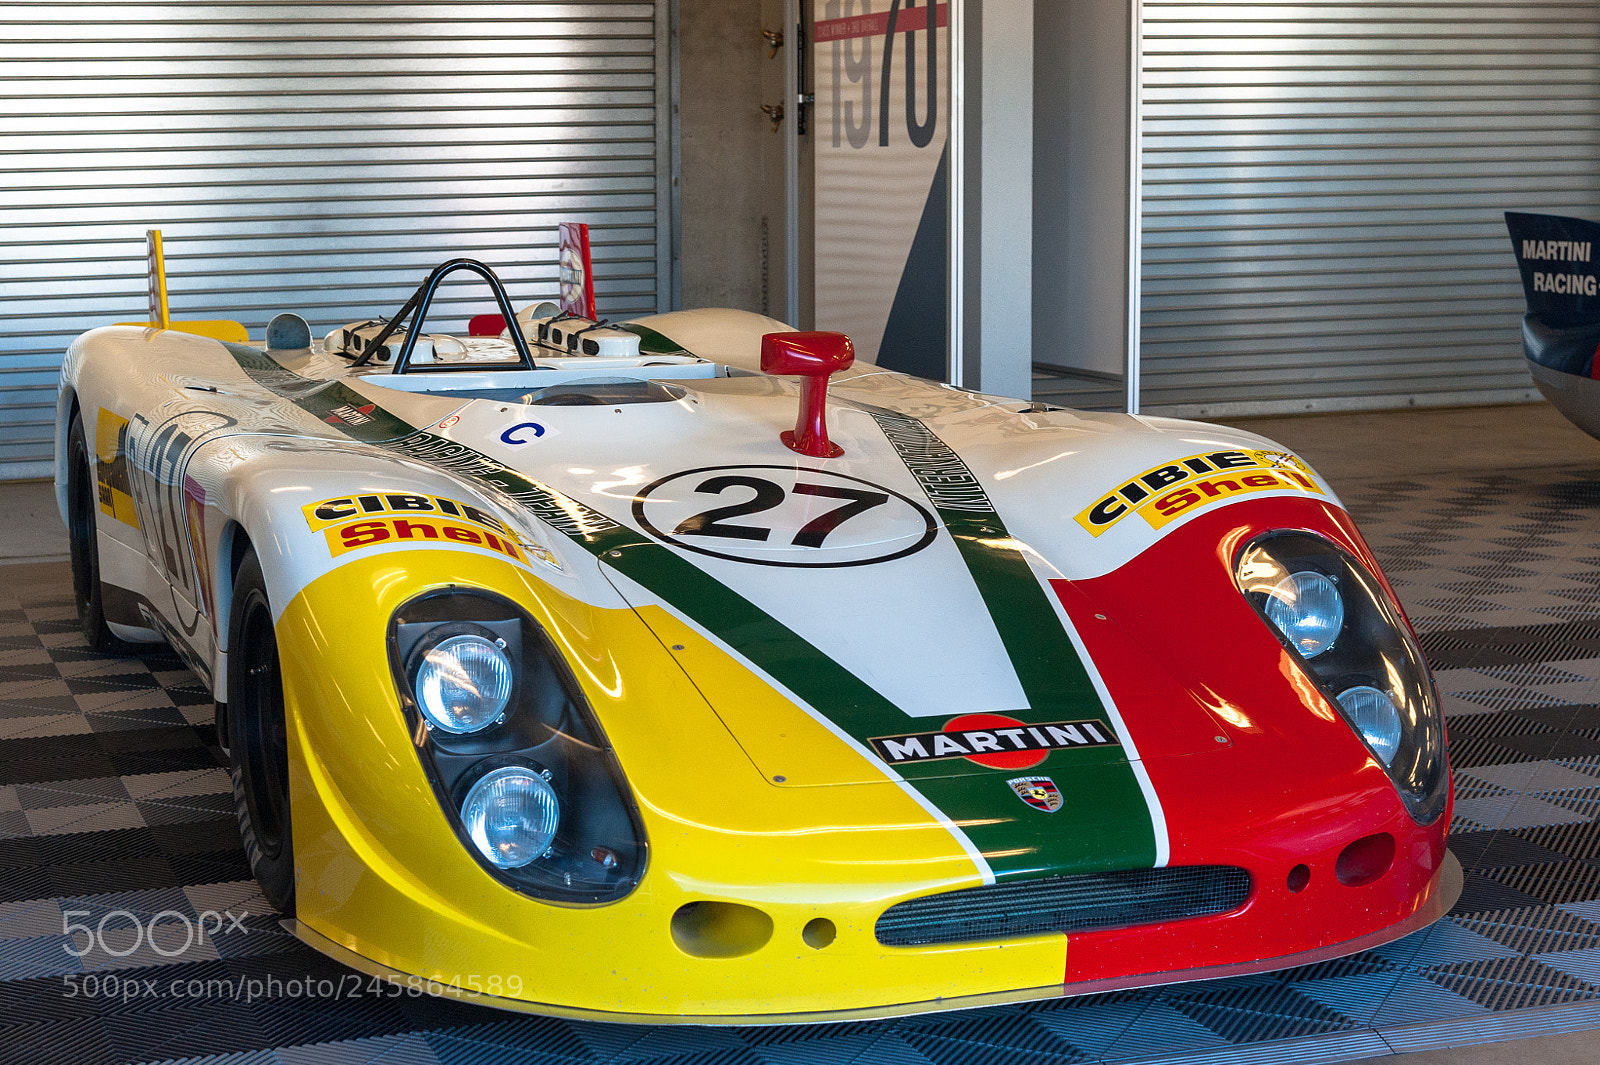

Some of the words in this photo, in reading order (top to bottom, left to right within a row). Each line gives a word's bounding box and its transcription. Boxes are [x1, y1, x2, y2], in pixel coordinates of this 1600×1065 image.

[825, 0, 938, 150] 1970
[1522, 239, 1592, 262] MARTINI
[1533, 271, 1597, 297] RACING
[330, 405, 371, 426] MARTINI
[499, 422, 545, 445] C
[1088, 451, 1259, 526] CIBIE
[1154, 471, 1314, 517] Shell
[314, 493, 507, 536] CIBIE
[671, 475, 890, 549] 27
[340, 520, 520, 560] Shell
[881, 723, 1108, 761] MARTINI
[1007, 776, 1051, 785] PORSCHE
